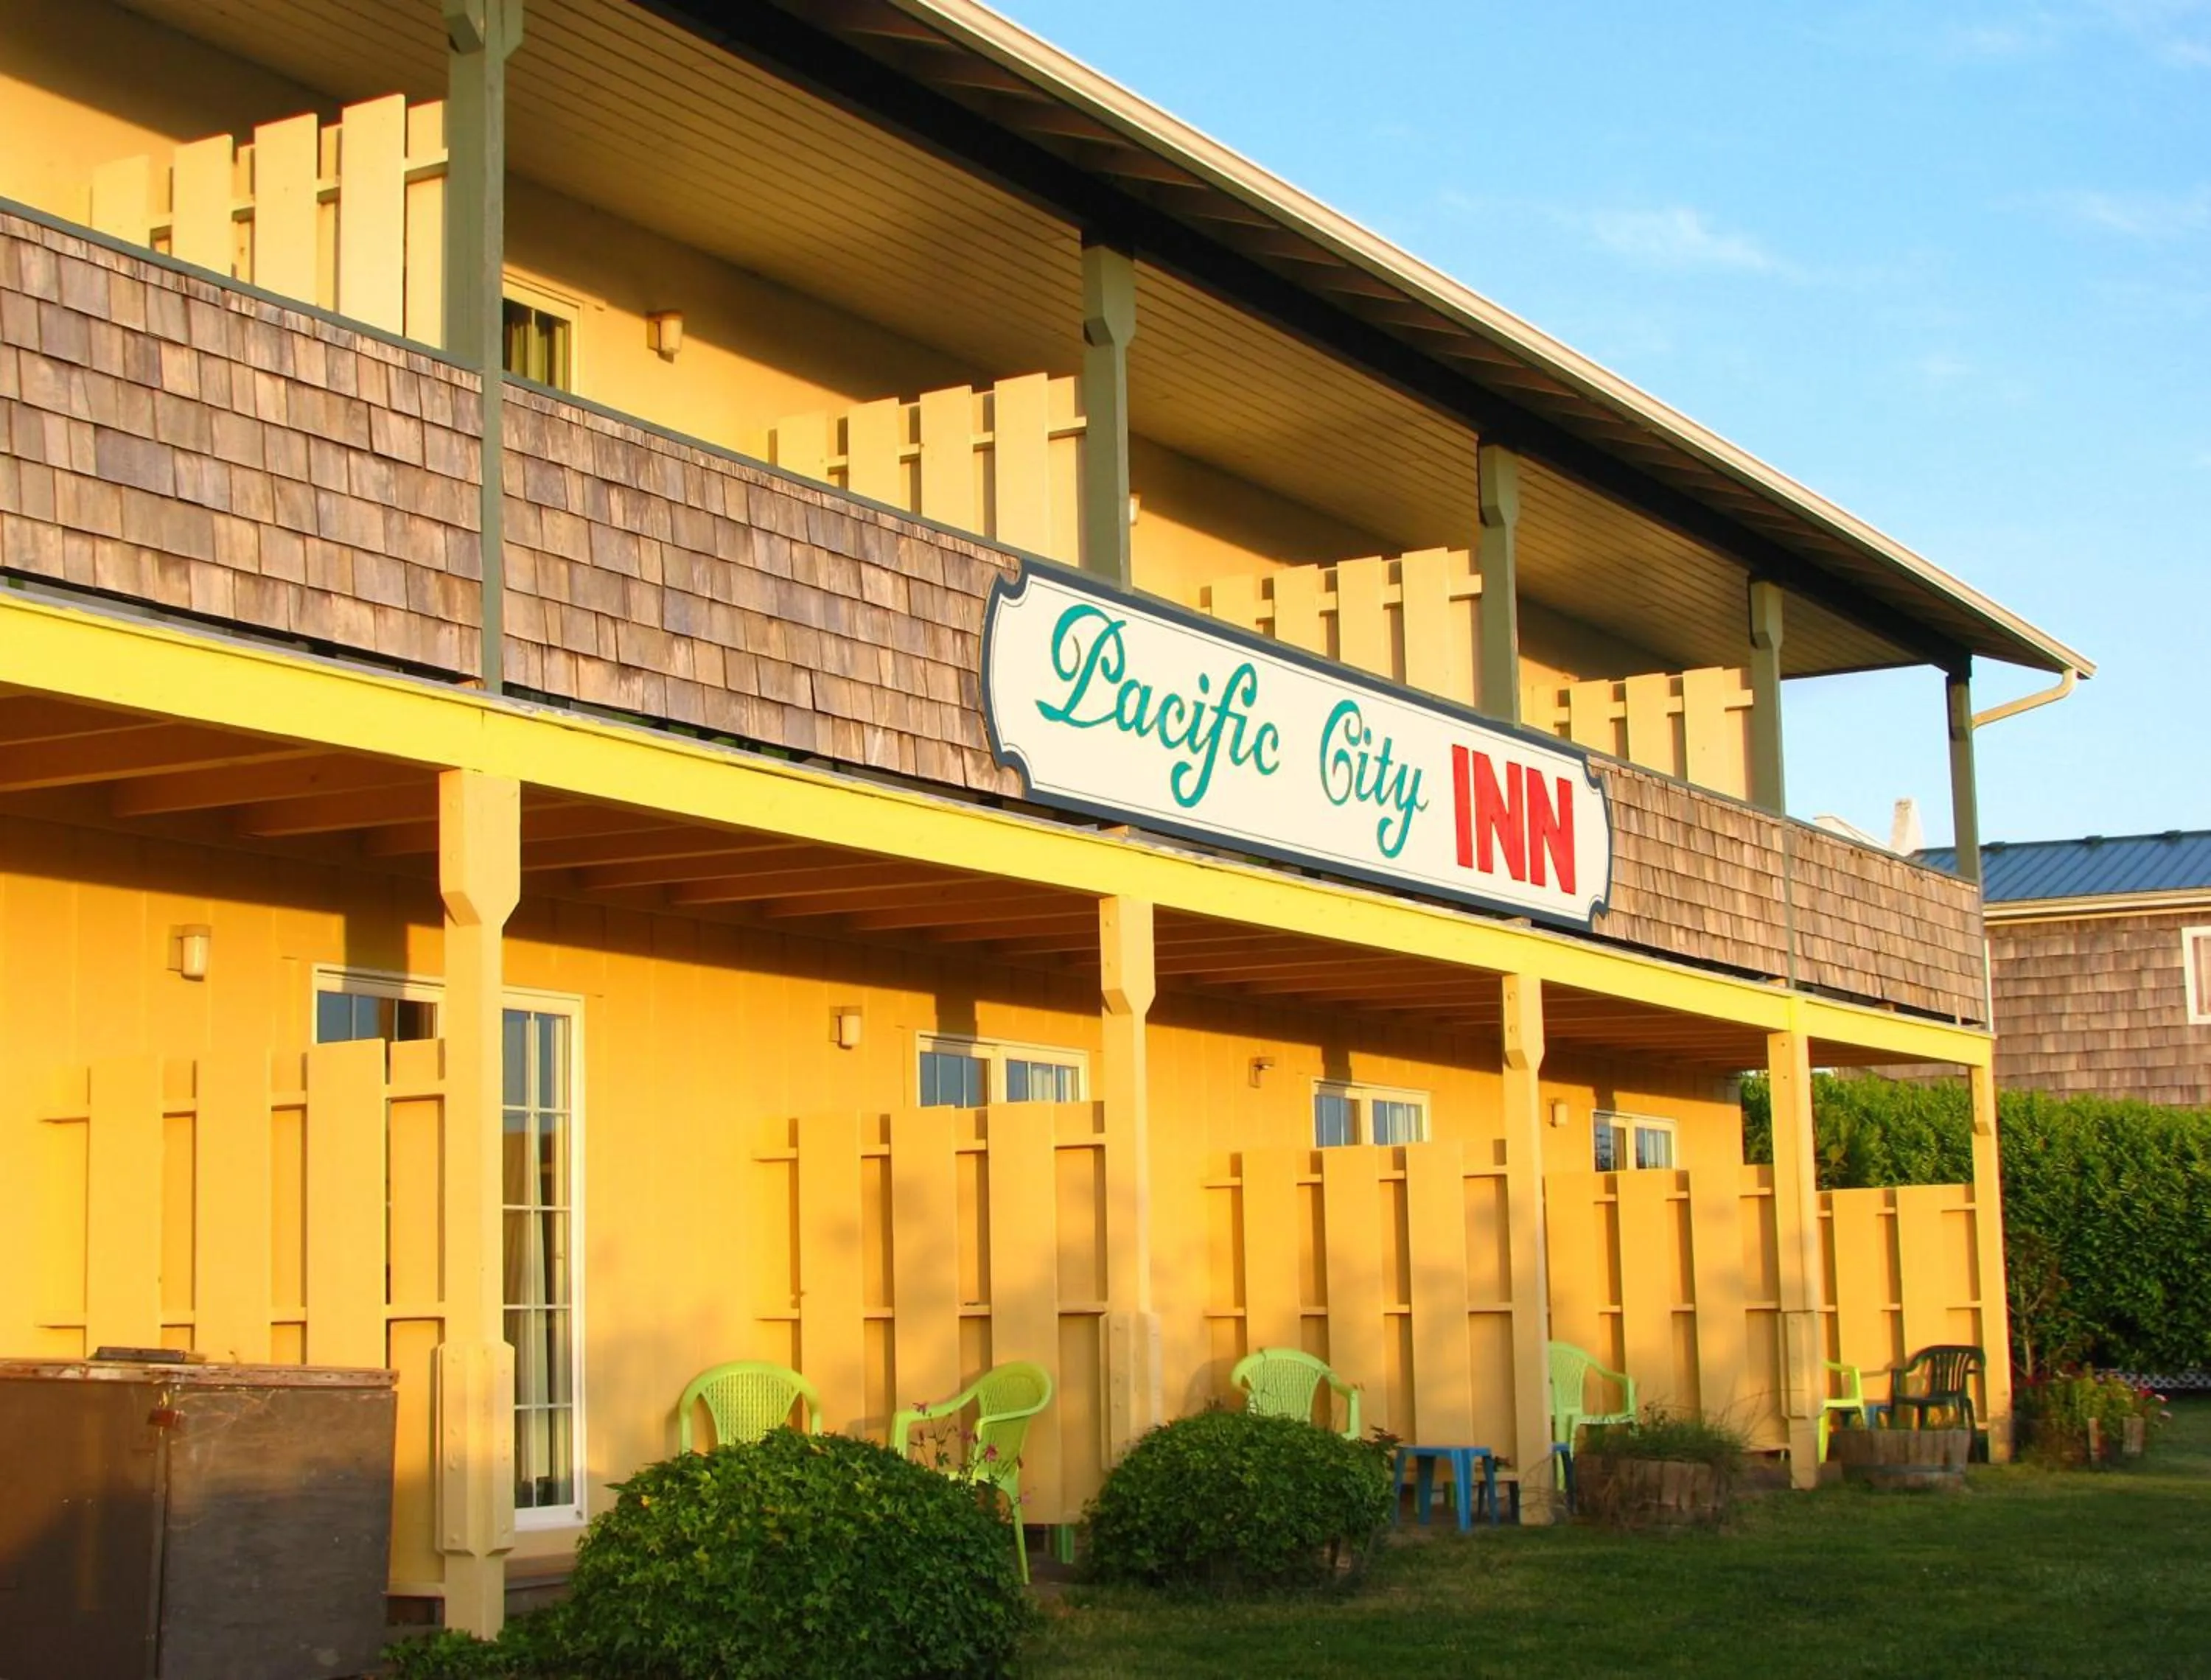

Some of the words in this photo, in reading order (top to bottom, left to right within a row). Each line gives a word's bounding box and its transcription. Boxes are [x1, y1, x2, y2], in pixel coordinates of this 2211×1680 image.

[1035, 603, 1280, 808] Pacific
[1319, 699, 1428, 859] City
[1451, 743, 1576, 896] INN
